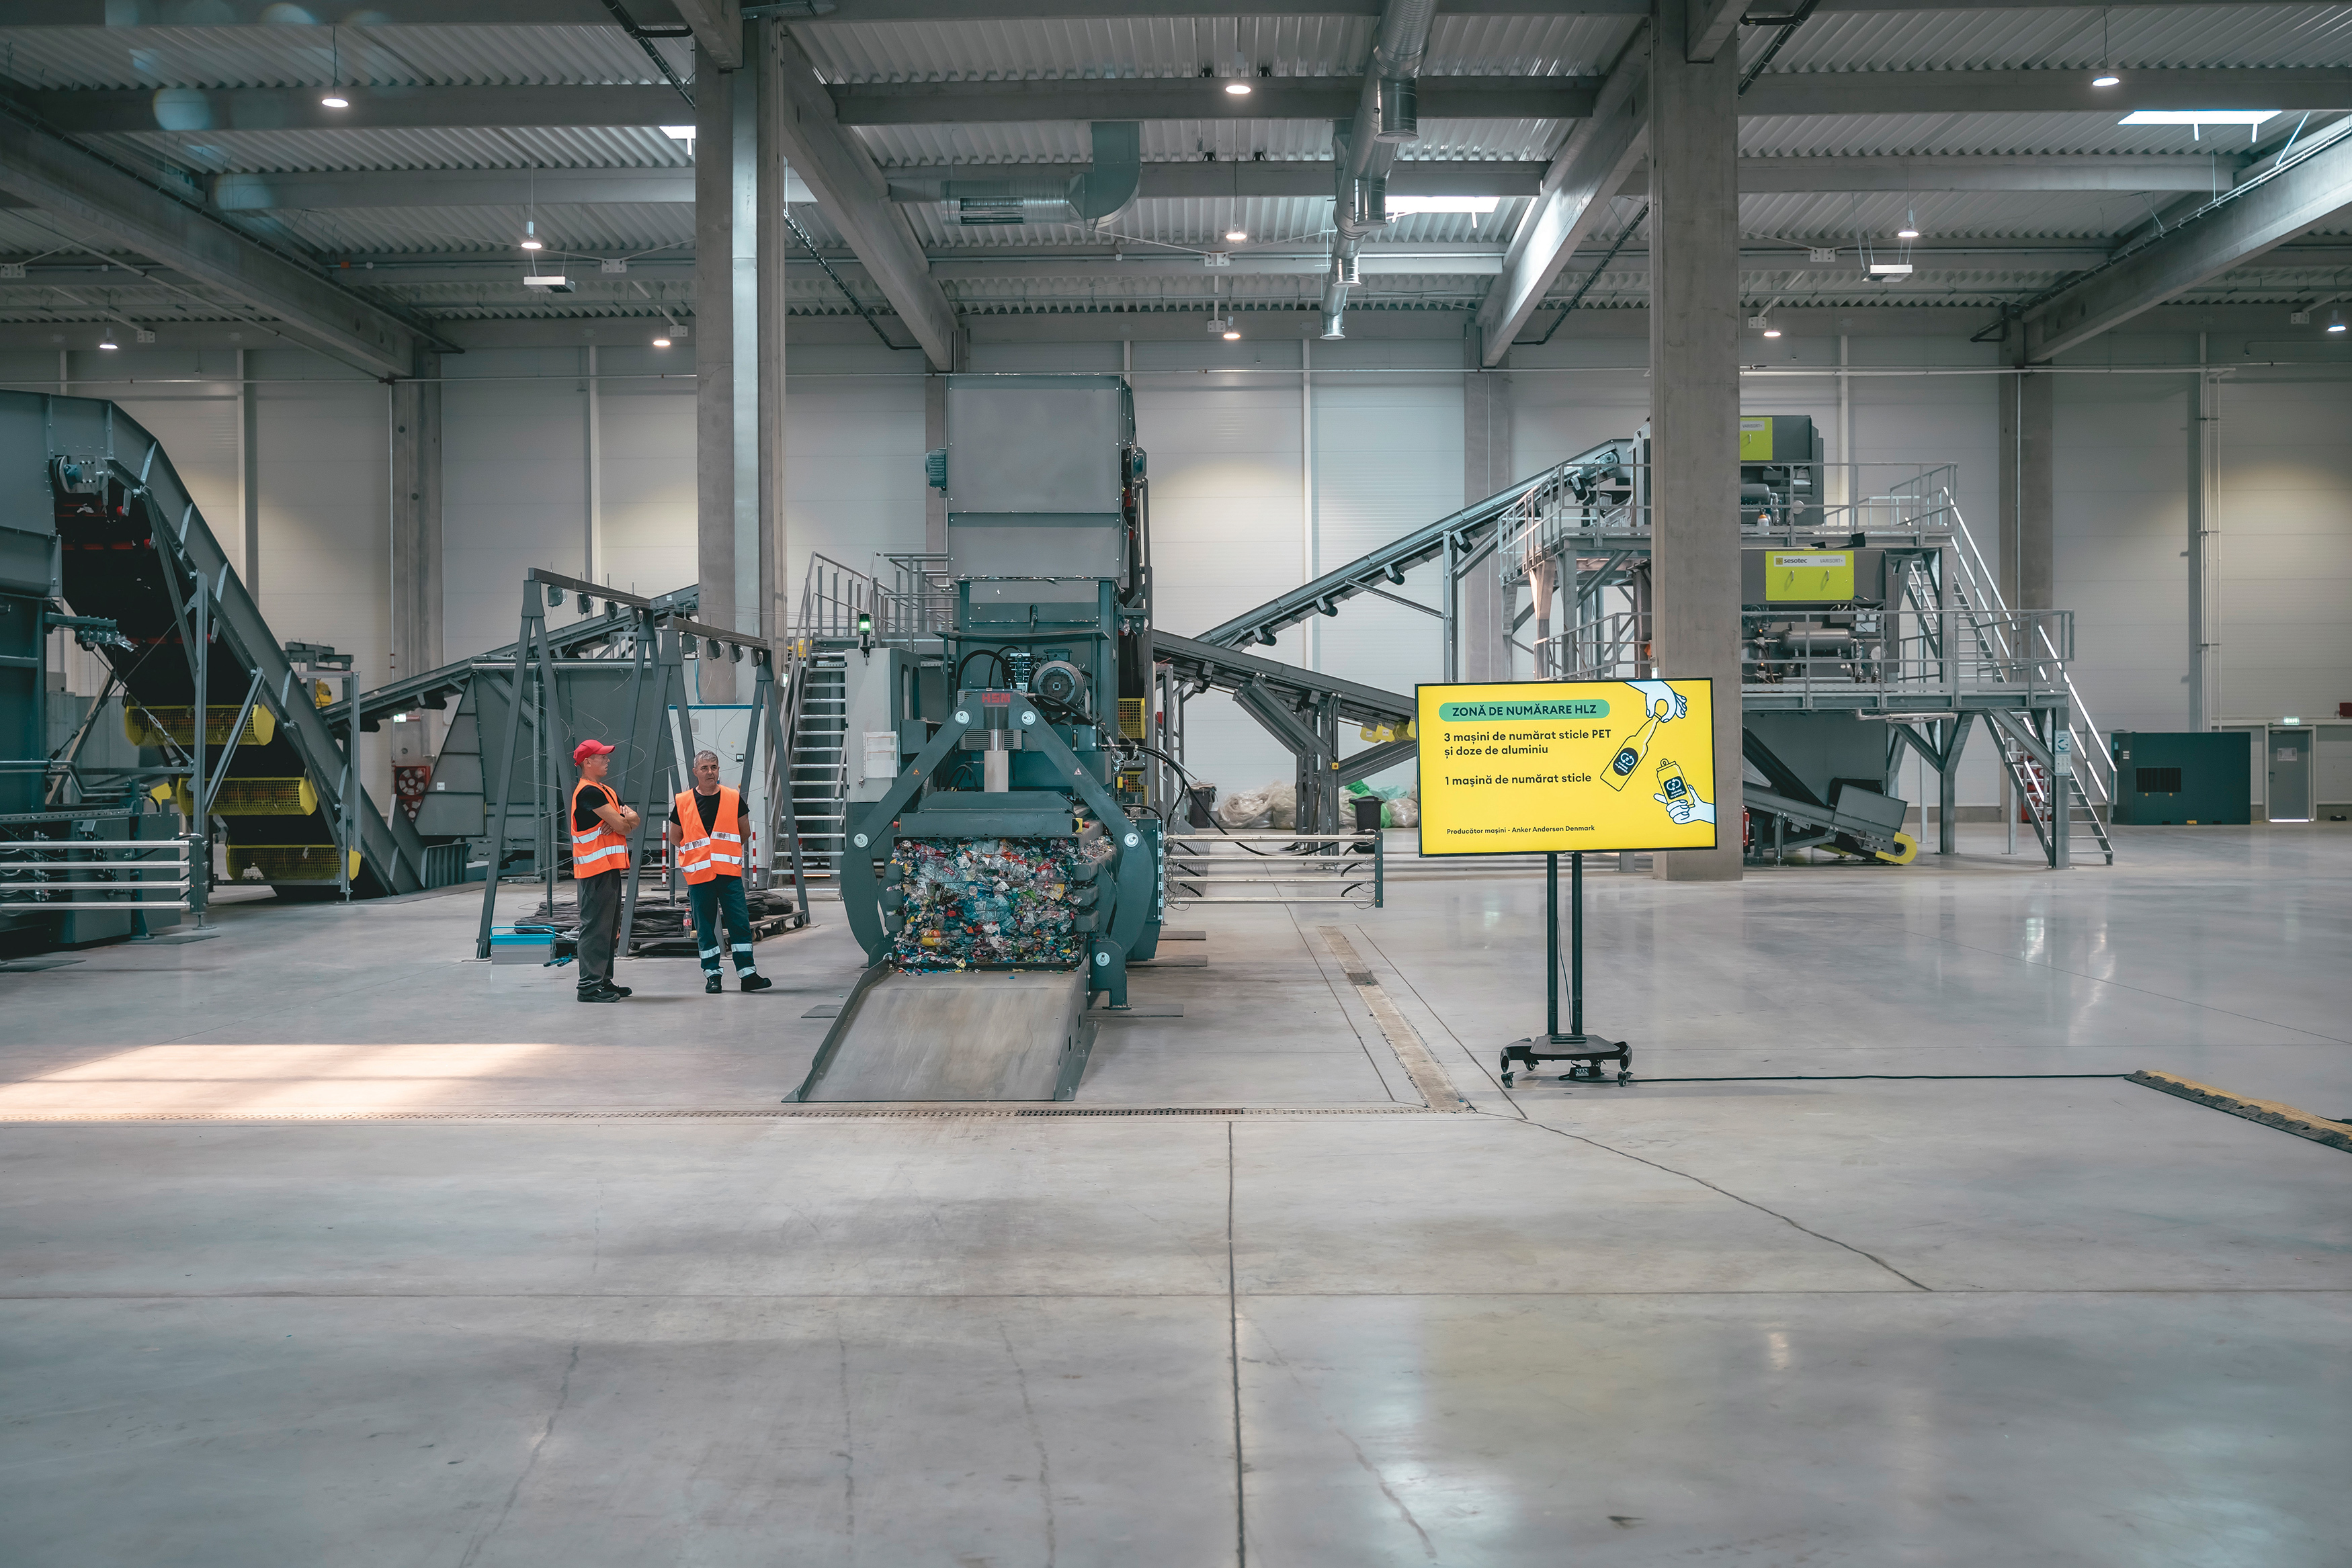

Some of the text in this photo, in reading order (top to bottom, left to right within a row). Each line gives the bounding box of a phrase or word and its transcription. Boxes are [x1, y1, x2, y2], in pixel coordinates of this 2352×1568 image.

[982, 693, 1011, 703] HSM
[1452, 703, 1597, 717] ZONĂ DE NUMĂRARE HLZ
[1443, 732, 1451, 742] 3
[1492, 731, 1507, 741] de
[1509, 730, 1556, 740] numărat
[1558, 729, 1589, 740] sticle
[1592, 729, 1611, 739] PET
[1444, 744, 1548, 759] și doze de aluminiu
[1445, 776, 1449, 785] 1
[1495, 774, 1509, 784] de
[1511, 773, 1559, 784] numărat
[1561, 773, 1592, 783] sticle
